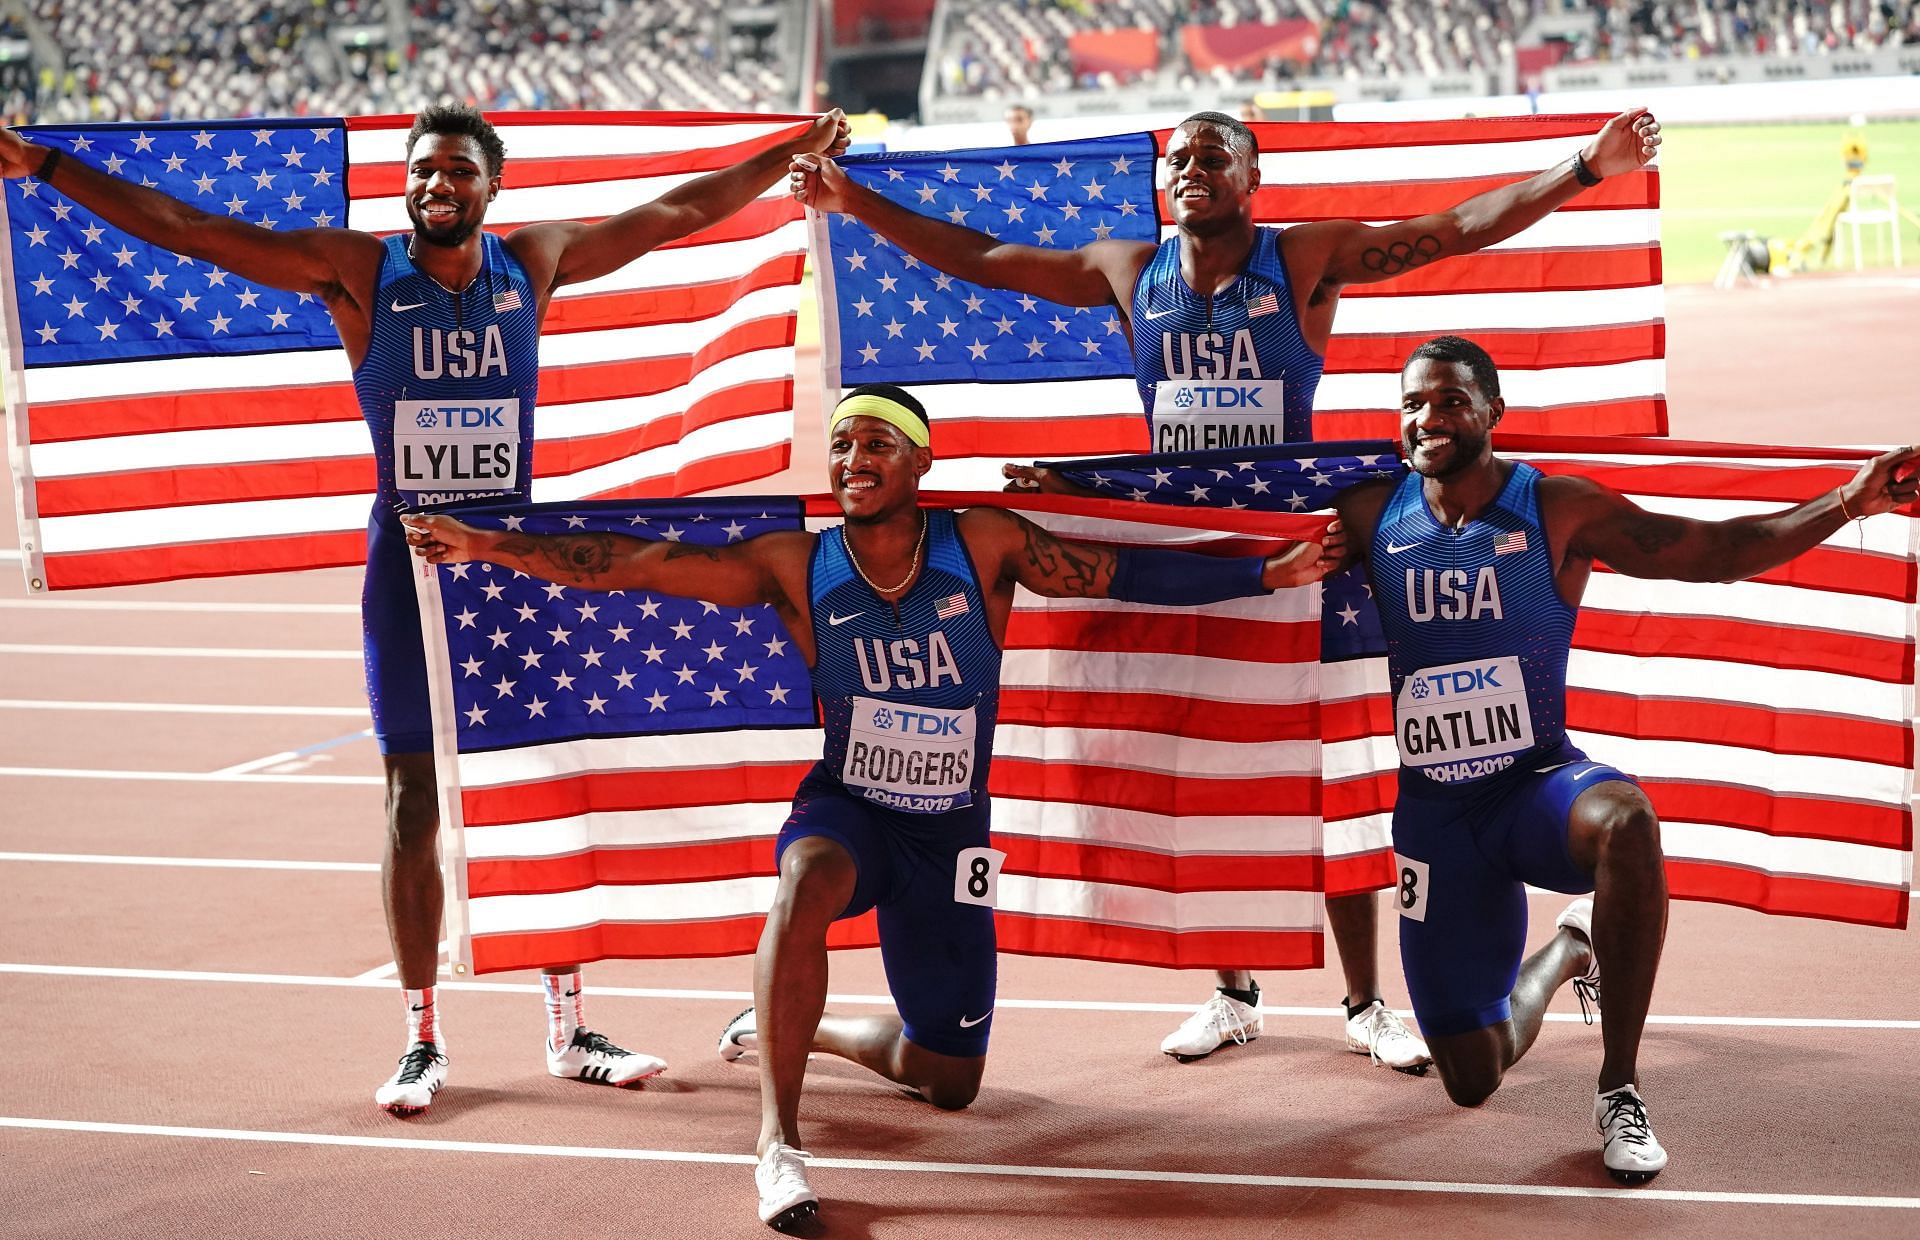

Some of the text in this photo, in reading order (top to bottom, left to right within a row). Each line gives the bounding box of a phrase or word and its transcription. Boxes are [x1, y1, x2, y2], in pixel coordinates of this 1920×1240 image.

[413, 324, 508, 380] USA
[1162, 328, 1262, 380] USA
[437, 406, 505, 428] TDK
[1194, 387, 1263, 408] TDK
[403, 442, 511, 480] LYLES
[1405, 566, 1503, 623] USA
[853, 630, 963, 693] USA
[1427, 665, 1503, 696] TDK
[894, 710, 963, 736] TDK
[1403, 703, 1522, 756] GATLIN
[849, 741, 969, 786] RODGERS
[967, 856, 990, 898] 8
[1400, 866, 1418, 909] 8
